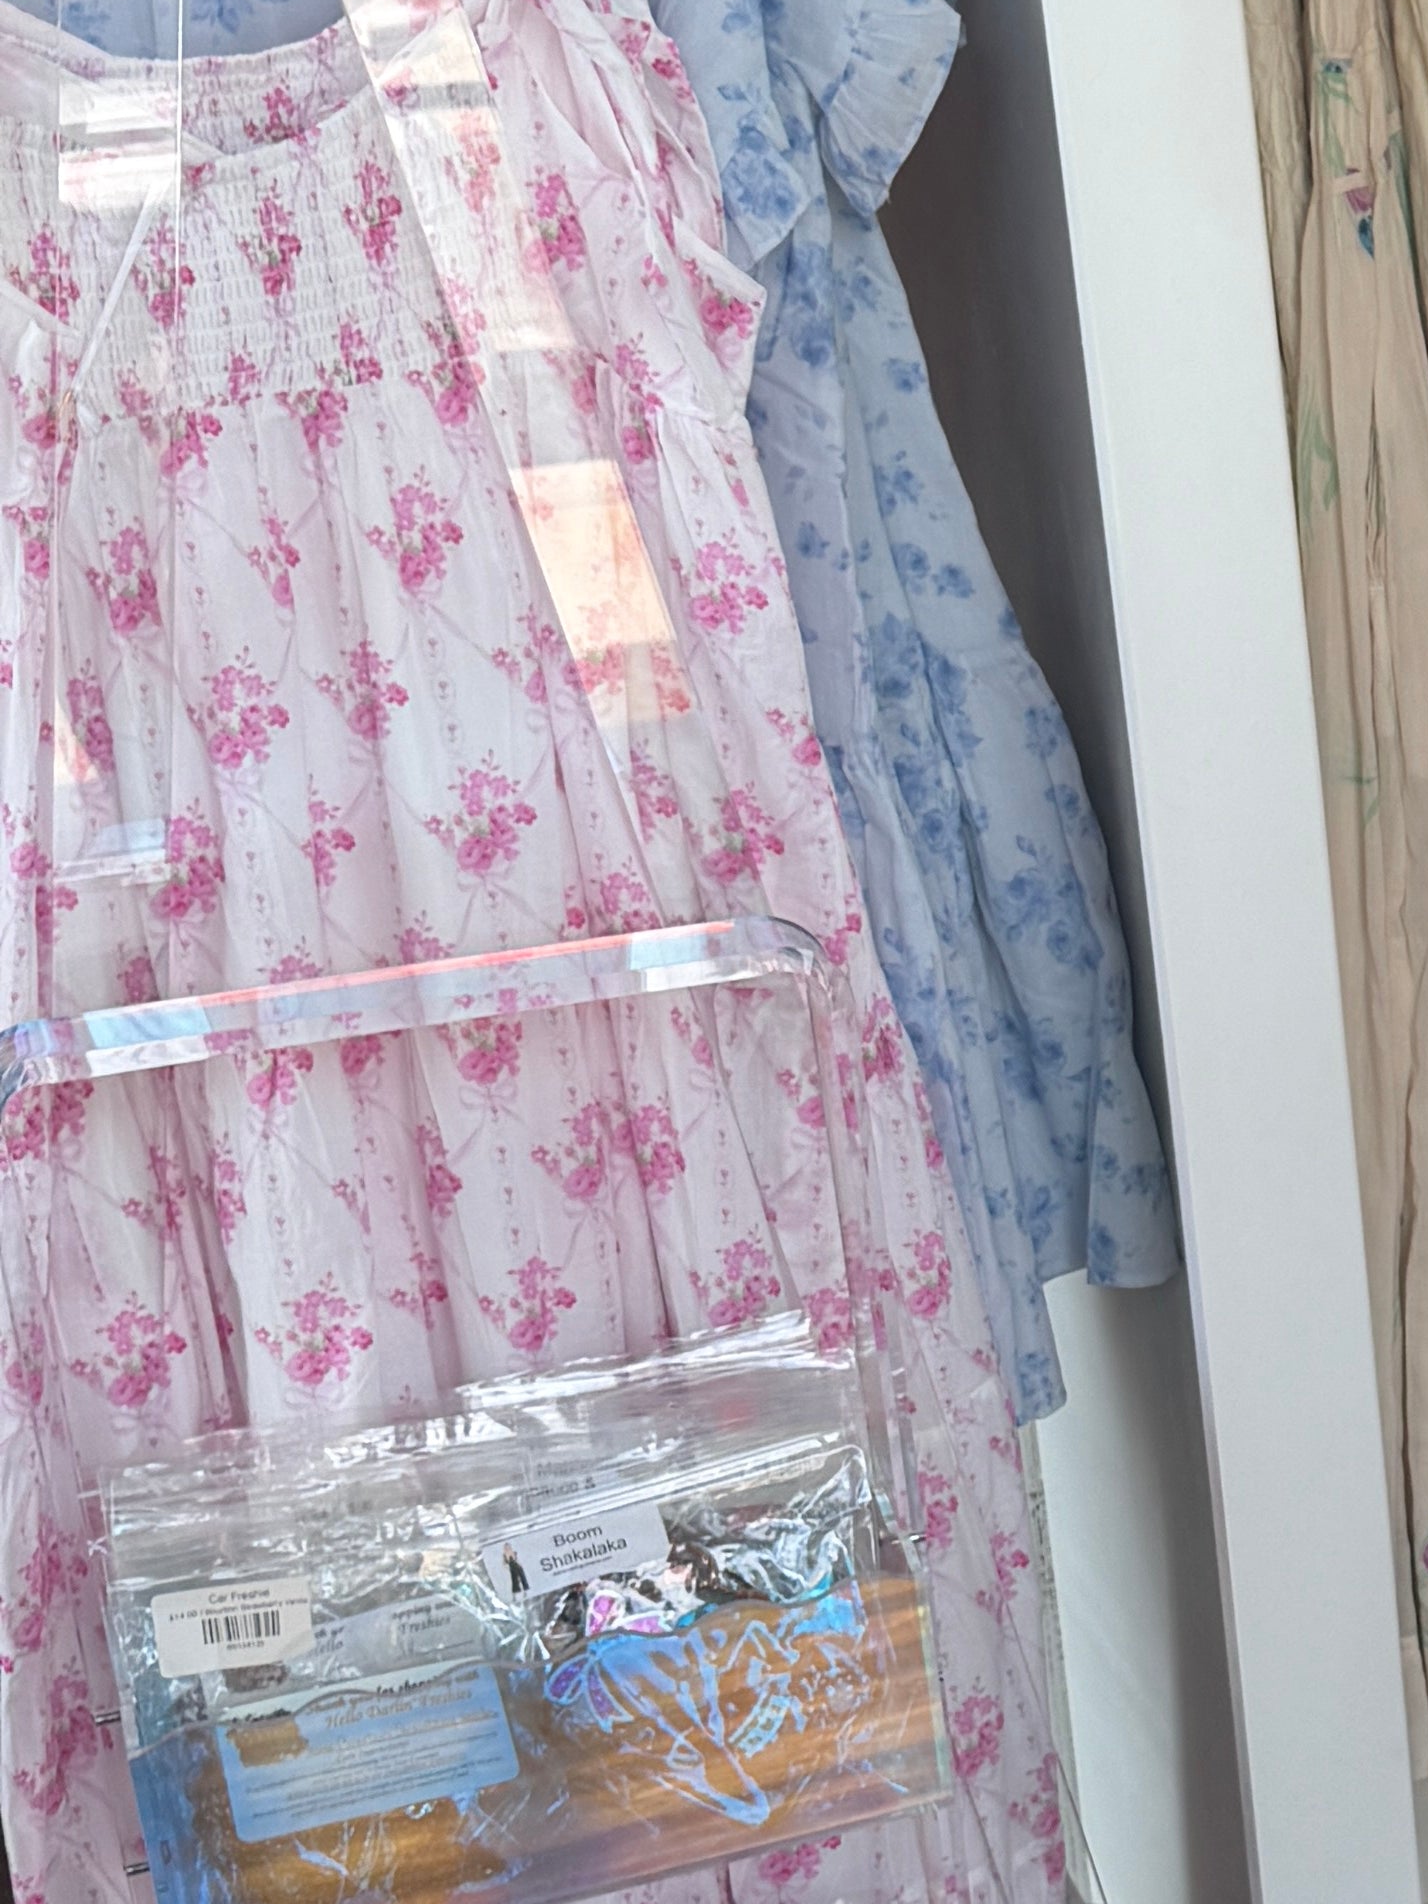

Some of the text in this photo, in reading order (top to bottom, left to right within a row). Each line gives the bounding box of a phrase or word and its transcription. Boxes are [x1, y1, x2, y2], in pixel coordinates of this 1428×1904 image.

[552, 1525, 603, 1547] Boom
[540, 1537, 628, 1572] Shakalaka
[208, 1592, 227, 1604] Car
